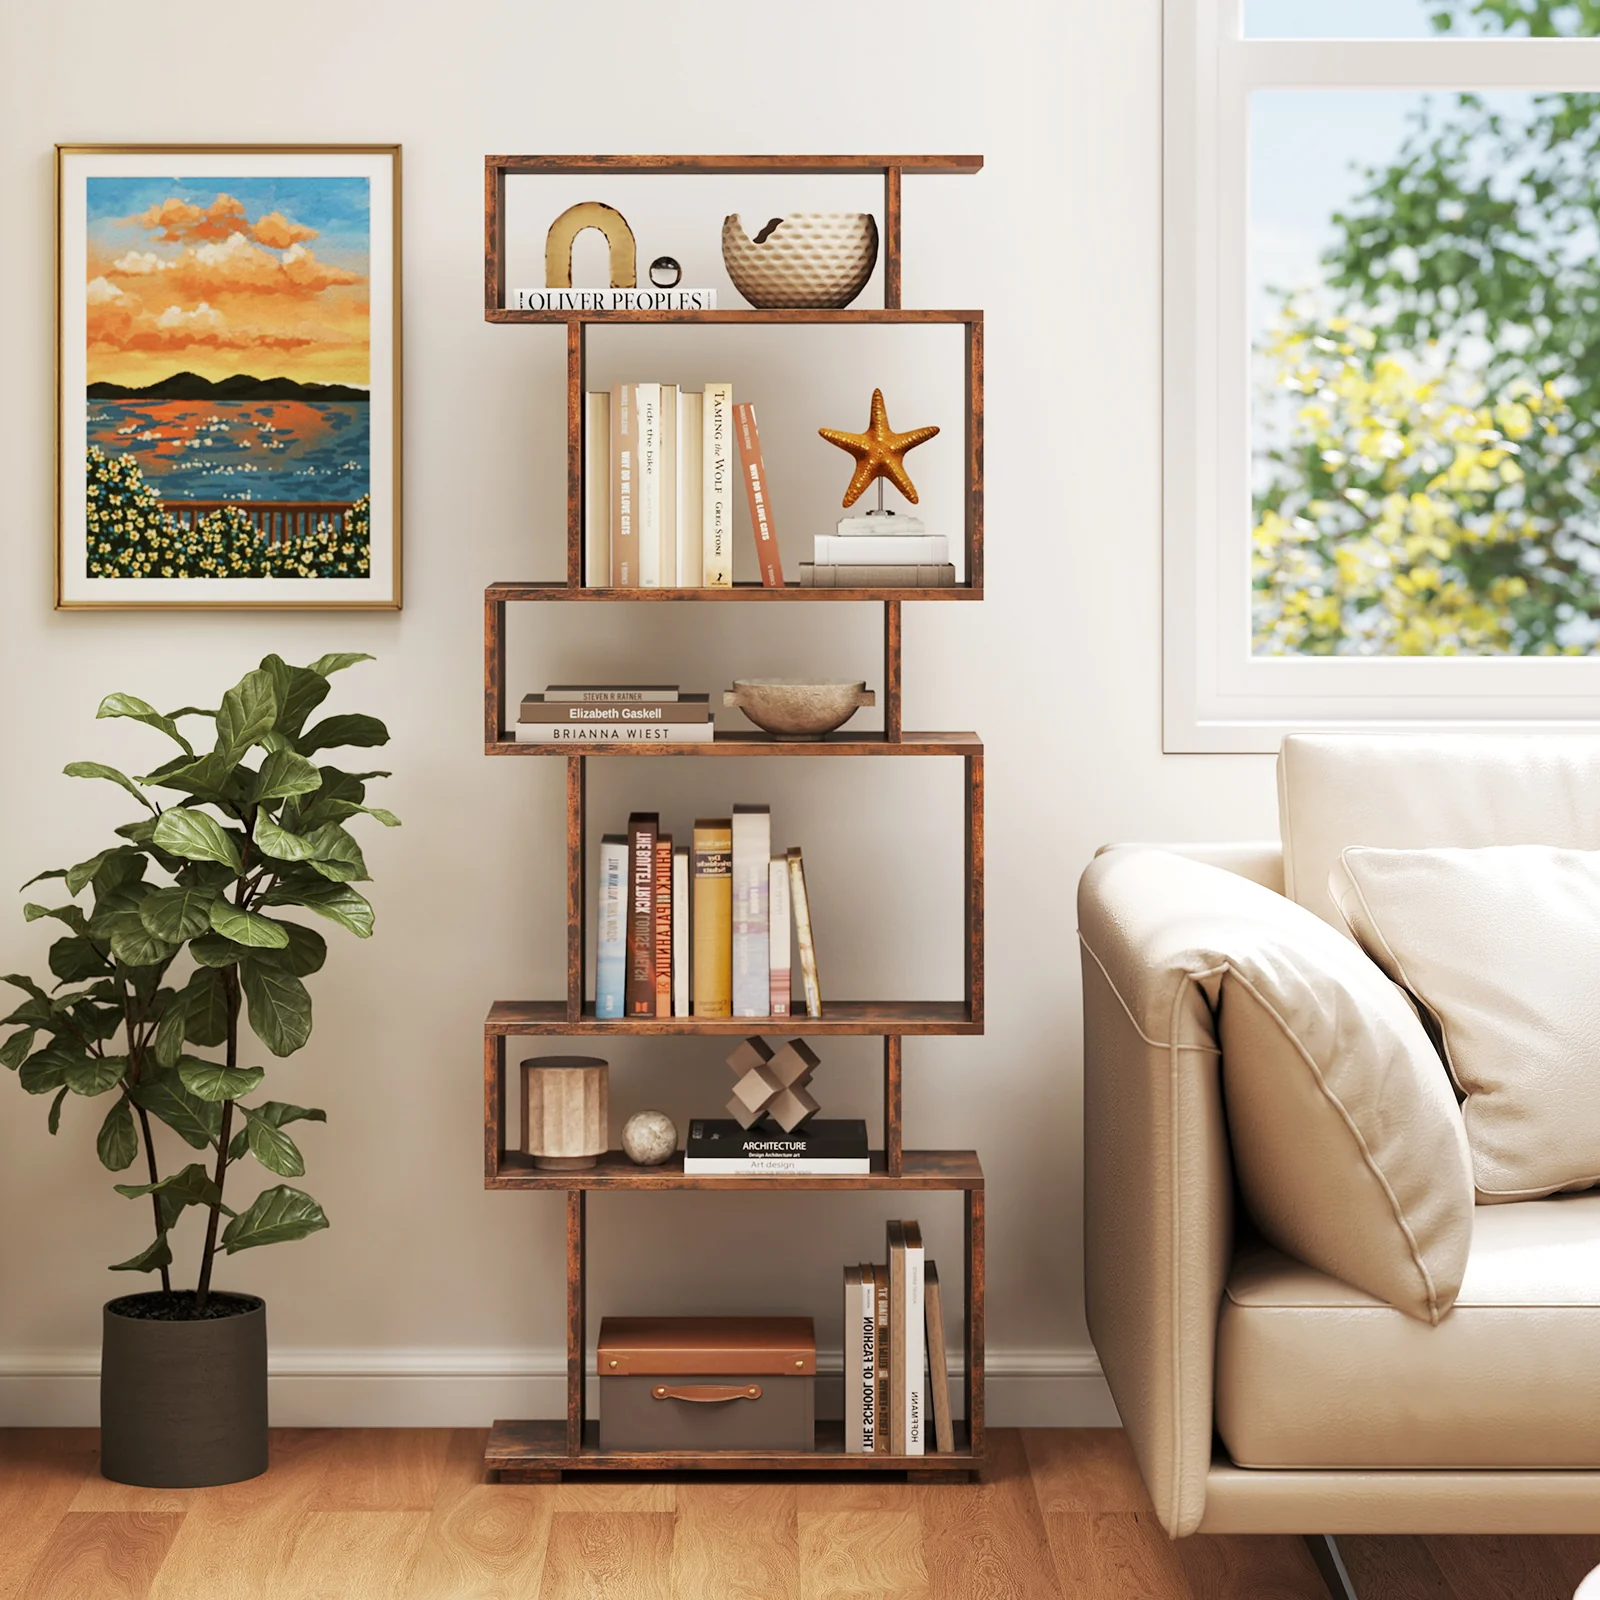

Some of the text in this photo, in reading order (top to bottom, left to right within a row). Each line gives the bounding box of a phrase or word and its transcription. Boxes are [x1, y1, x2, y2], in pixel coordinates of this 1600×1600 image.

[528, 292, 604, 310] OLIVER
[613, 292, 702, 310] PEOPLES
[714, 390, 725, 557] TAMING the WOLF GREG STONE
[621, 451, 630, 535] WHY DO WE LOVE CATS
[749, 463, 770, 541] WHY DO WE LOVE CATS
[583, 693, 643, 701] STEVEN R RATNER
[569, 708, 662, 719] Elizabeth Gaskell
[553, 729, 669, 739] BRIANNA WIEST
[742, 1141, 807, 1150] ARCHITECTURE
[765, 1161, 795, 1169] design
